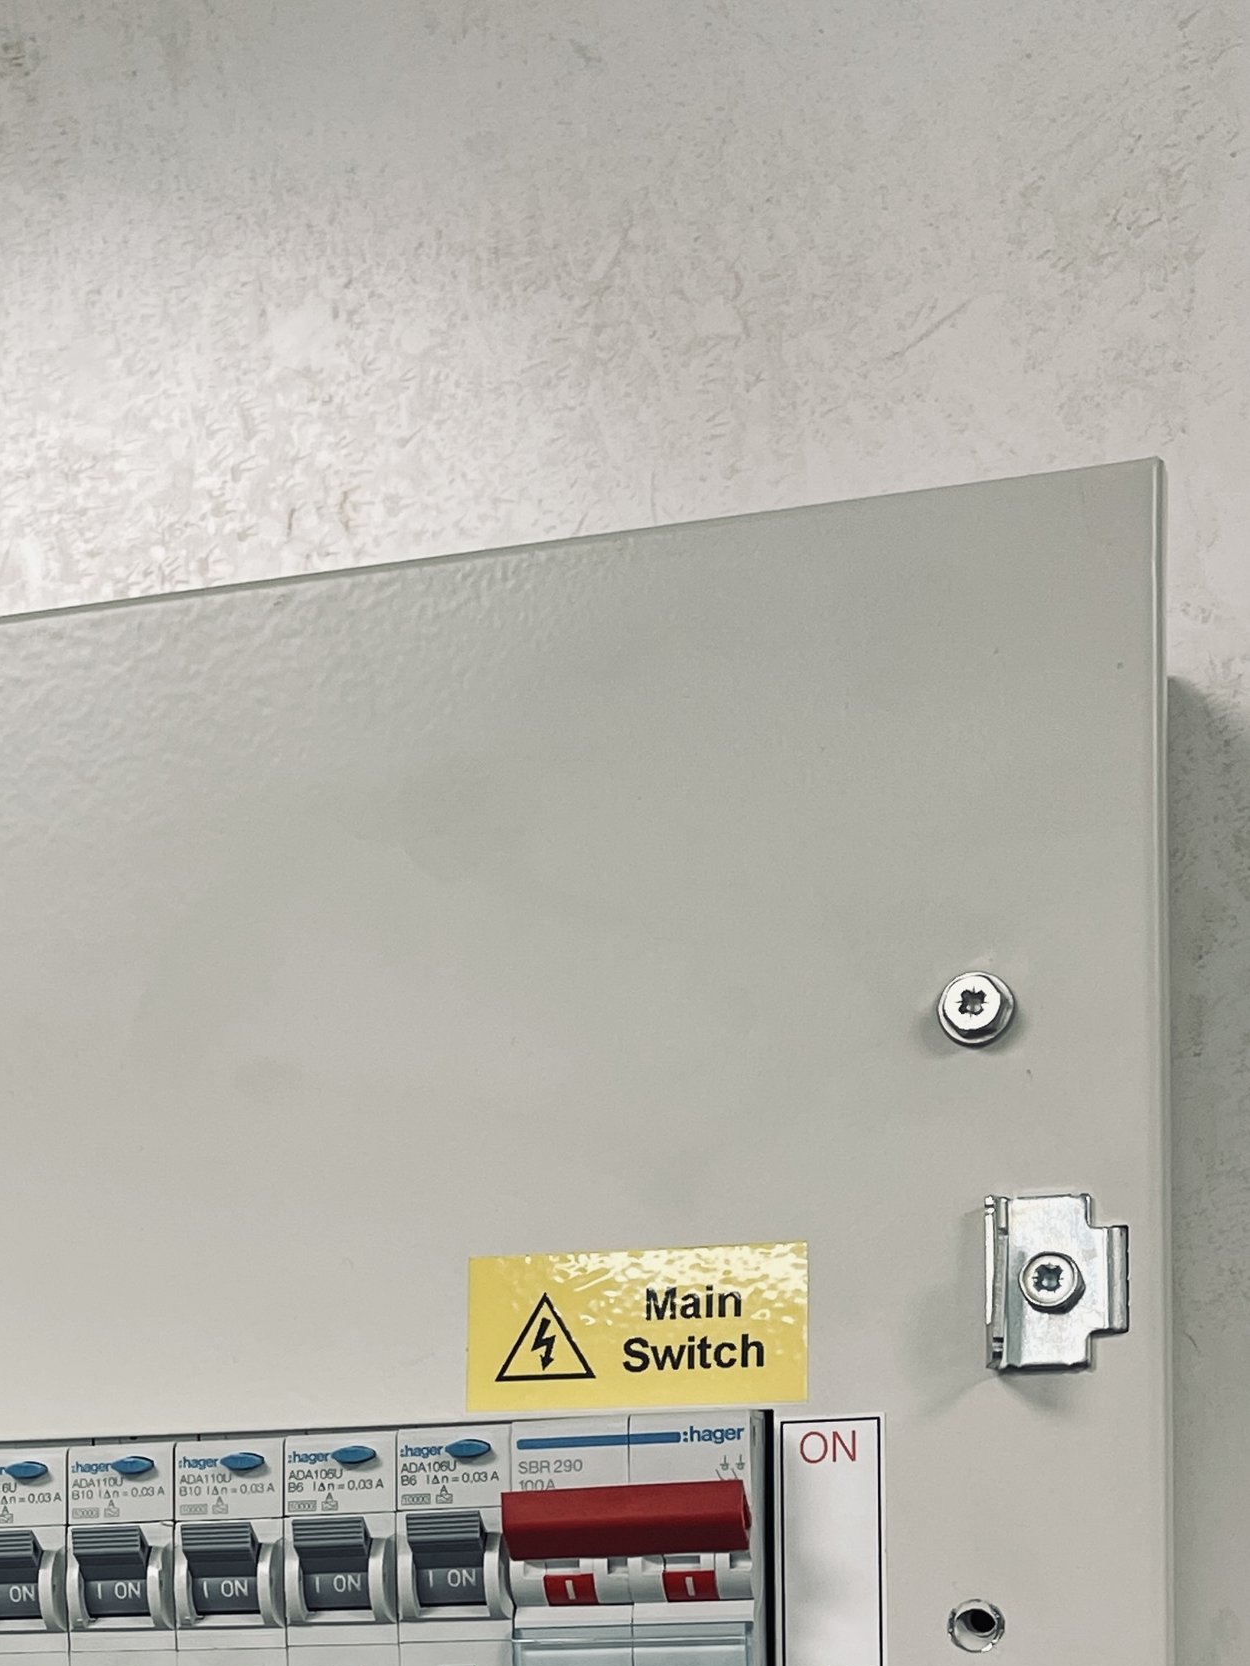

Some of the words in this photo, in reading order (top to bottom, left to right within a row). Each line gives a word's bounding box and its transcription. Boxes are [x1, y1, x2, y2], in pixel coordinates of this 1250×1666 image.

[645, 1284, 742, 1321] Main
[623, 1334, 765, 1372] Switch
[799, 1429, 857, 1464] ON
[401, 1460, 457, 1473] ADA106U
[518, 1460, 552, 1475] SBR
[554, 1459, 583, 1473] 290
[288, 1482, 304, 1493] B6
[401, 1475, 417, 1486] B6
[72, 1490, 93, 1500] B10
[179, 1486, 201, 1496] B10
[333, 1573, 362, 1592] ON
[447, 1568, 477, 1588] ON
[9, 1584, 36, 1603] ON
[114, 1582, 141, 1599] ON
[220, 1579, 249, 1598] ON
